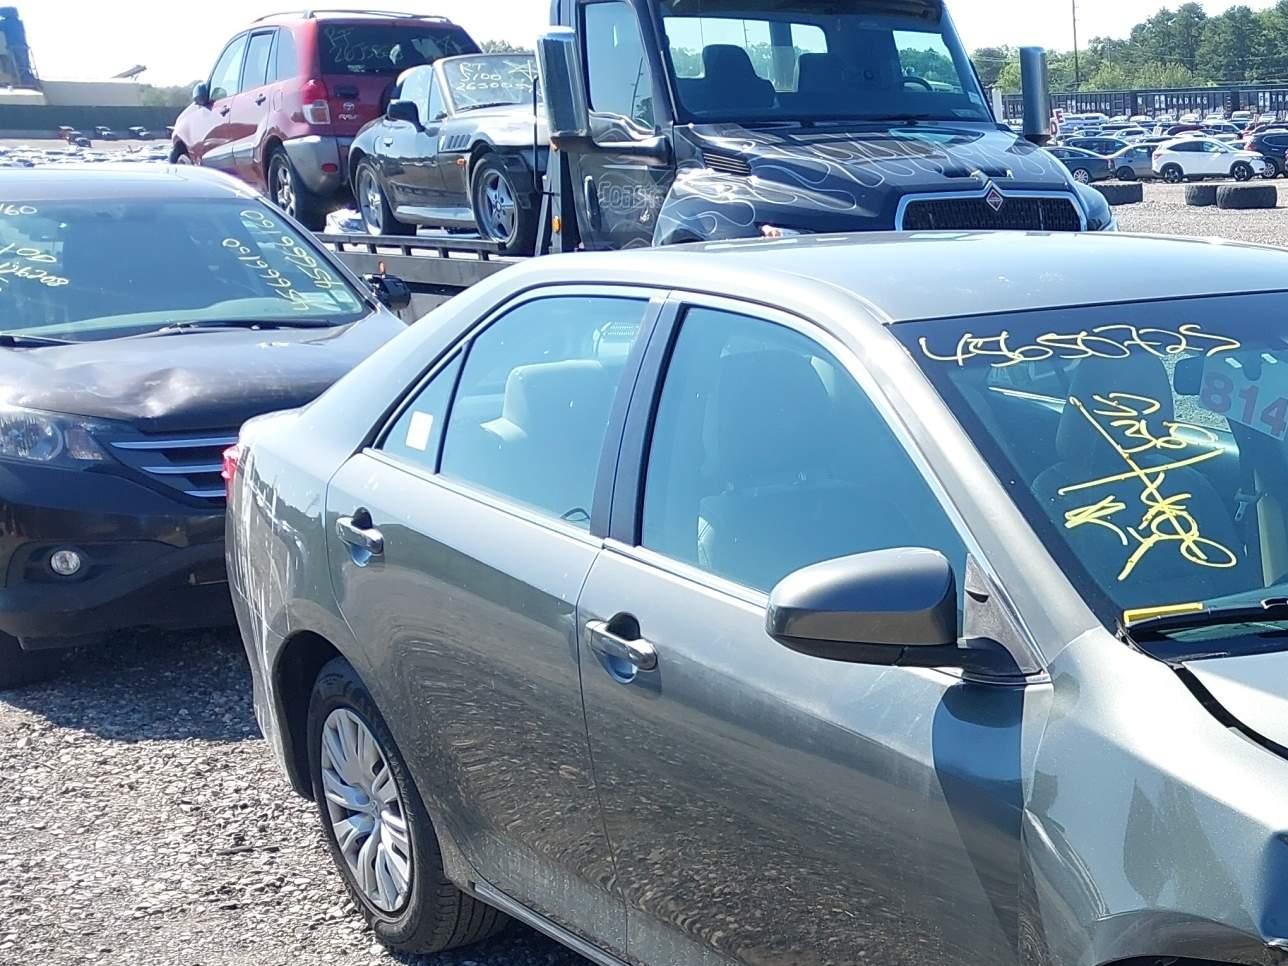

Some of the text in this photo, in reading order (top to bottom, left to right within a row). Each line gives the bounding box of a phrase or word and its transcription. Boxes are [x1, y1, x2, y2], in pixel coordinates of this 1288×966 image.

[1077, 101, 1110, 111] TRADING
[1167, 97, 1208, 105] TRADING
[918, 323, 1241, 366] 45650725
